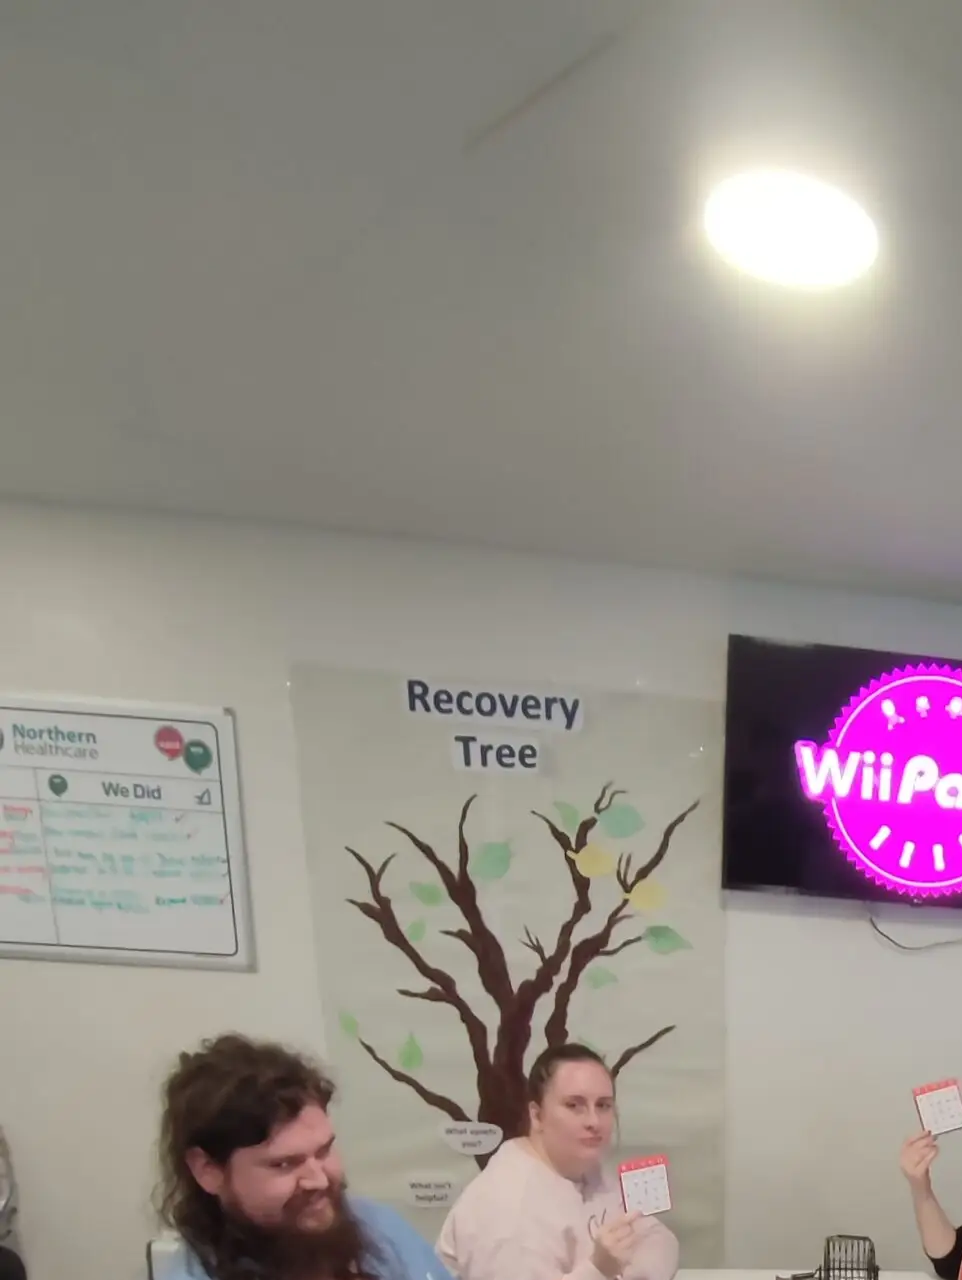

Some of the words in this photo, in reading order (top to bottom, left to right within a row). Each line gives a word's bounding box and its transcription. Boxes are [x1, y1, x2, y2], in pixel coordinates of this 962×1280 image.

[406, 679, 579, 730] Recovery
[12, 723, 97, 745] Northern
[14, 740, 99, 760] Healthcare
[454, 735, 538, 768] Tree
[102, 781, 130, 798] We
[133, 784, 162, 800] Did
